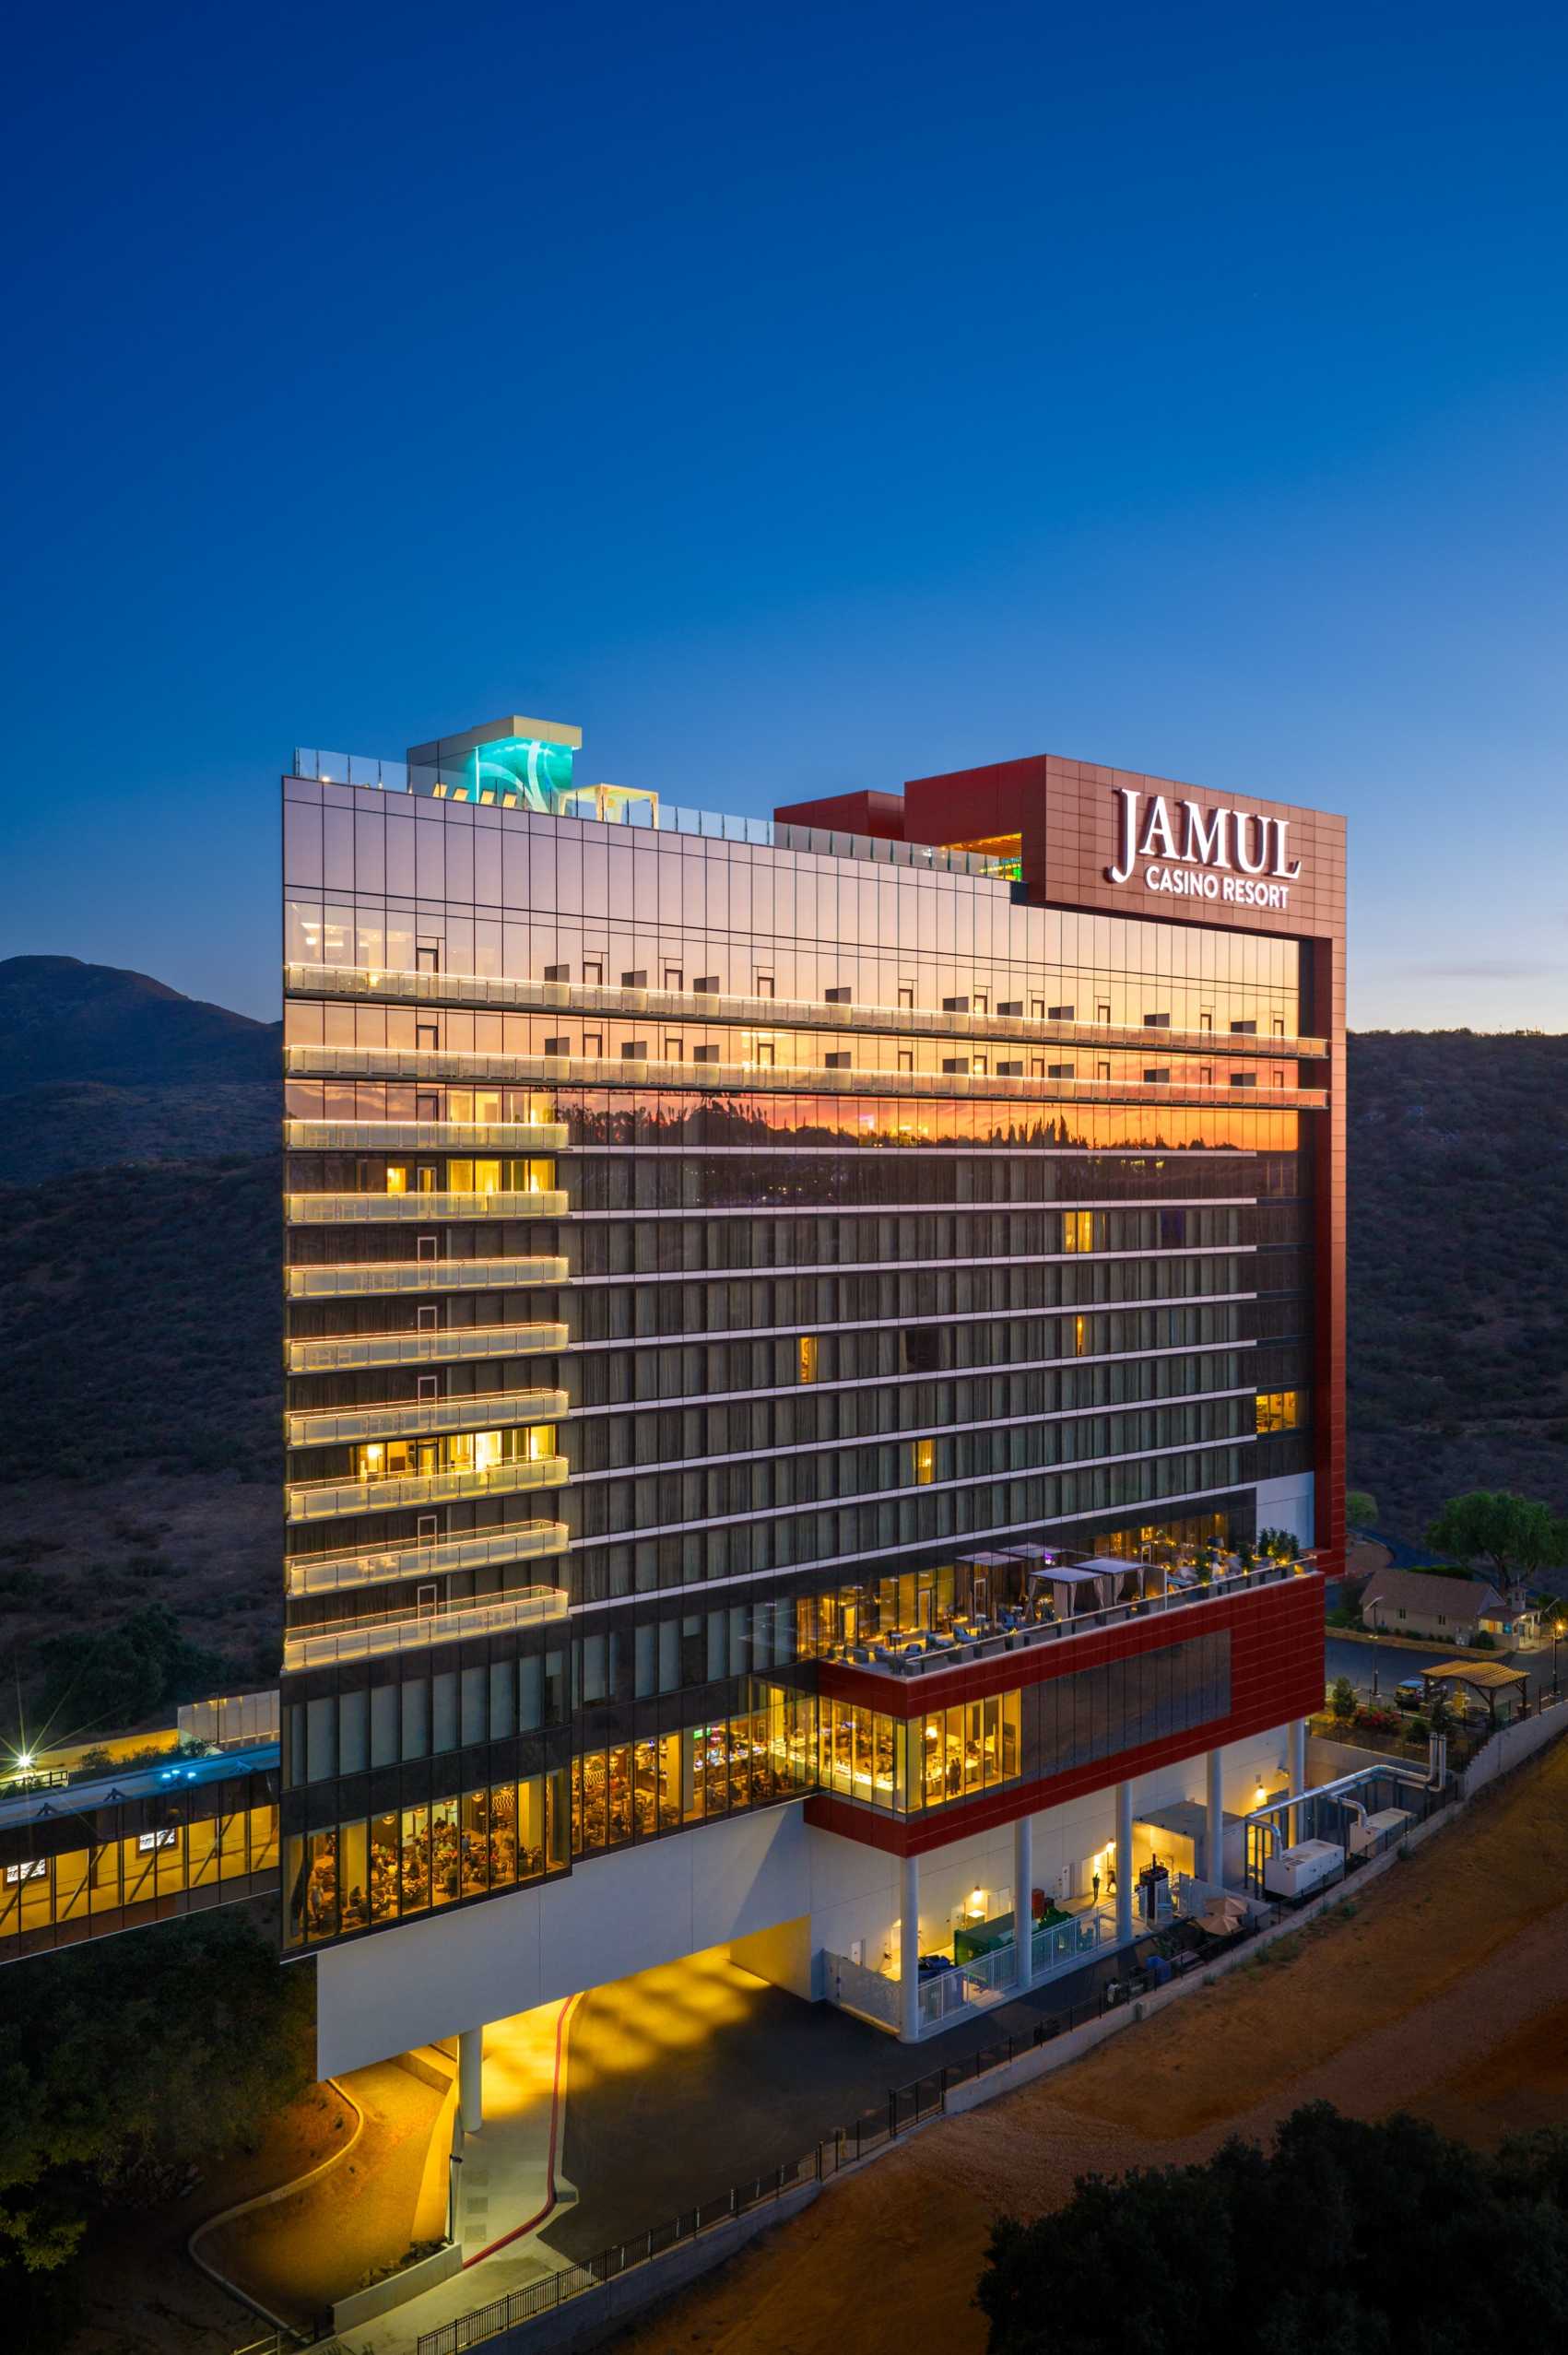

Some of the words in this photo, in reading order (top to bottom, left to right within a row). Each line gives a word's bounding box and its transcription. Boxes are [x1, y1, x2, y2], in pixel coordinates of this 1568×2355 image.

[1111, 788, 1302, 883] JAMUL
[1146, 865, 1218, 899] CASINO
[1222, 877, 1290, 909] RESORT
